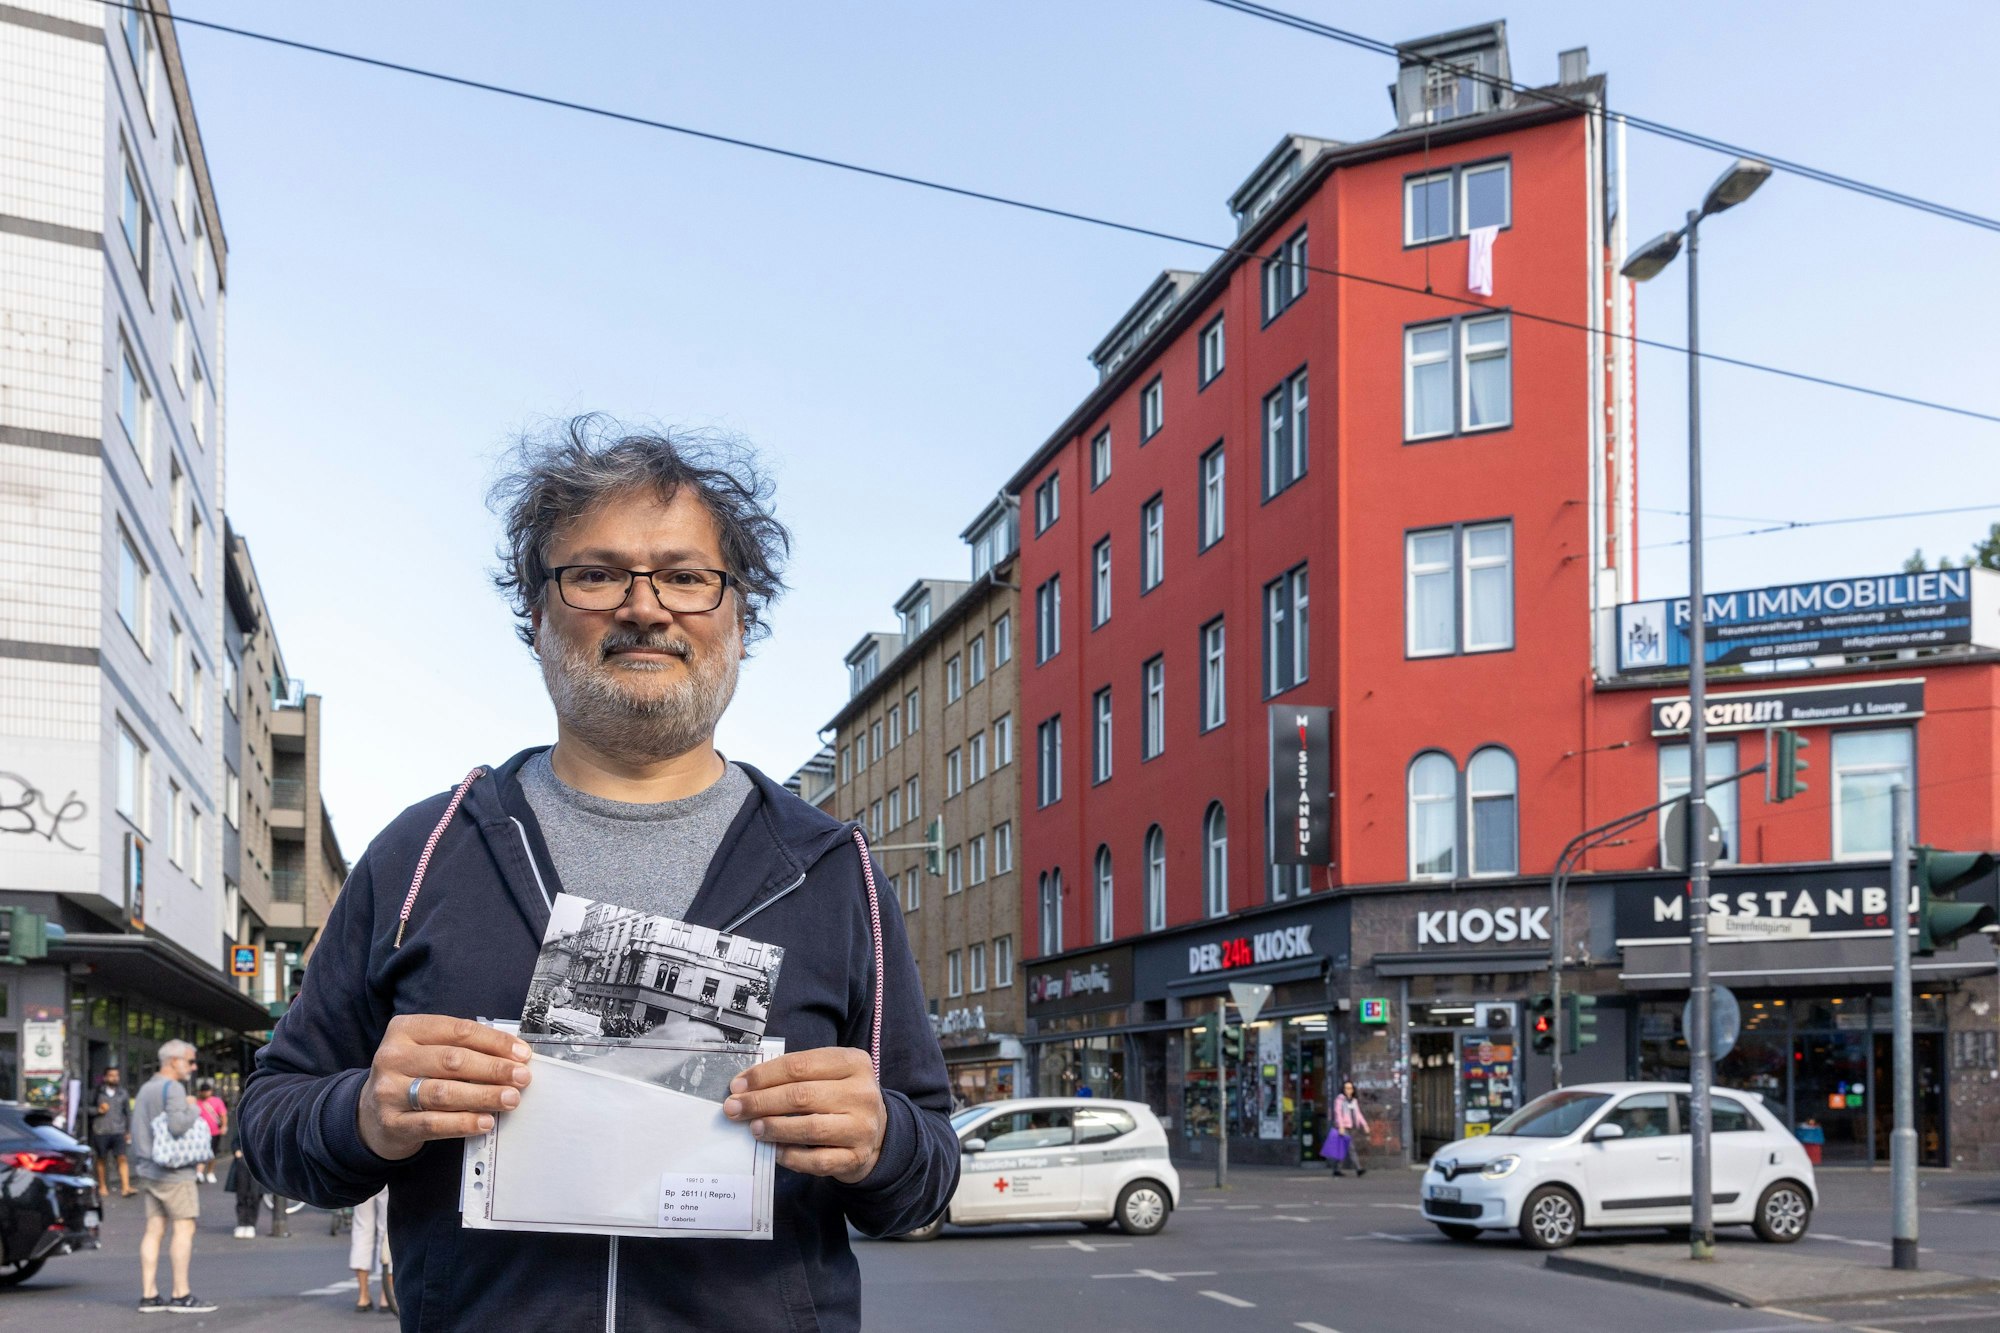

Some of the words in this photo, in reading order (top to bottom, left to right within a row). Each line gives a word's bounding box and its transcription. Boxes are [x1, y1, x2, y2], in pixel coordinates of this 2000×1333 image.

[1674, 594, 1737, 626] RM
[1748, 570, 1966, 619] IMMOBILIEN
[1717, 619, 1804, 637] Hausverwaltung
[1820, 611, 1886, 628] Vermietung
[1902, 605, 1947, 619] Verkauf
[1659, 700, 1784, 729] Mcnun
[1791, 705, 1849, 719] Restaurant
[1853, 703, 1863, 714] &
[1867, 701, 1908, 715] Lounge
[1417, 906, 1551, 944] KIOSK
[1725, 918, 1793, 935] Ehrenfeldgürtel
[1189, 943, 1222, 974] DER
[1221, 937, 1253, 969] 24h
[1254, 924, 1313, 964] KIOSK
[665, 1189, 676, 1197] Bp
[709, 1191, 736, 1200] Repro.)
